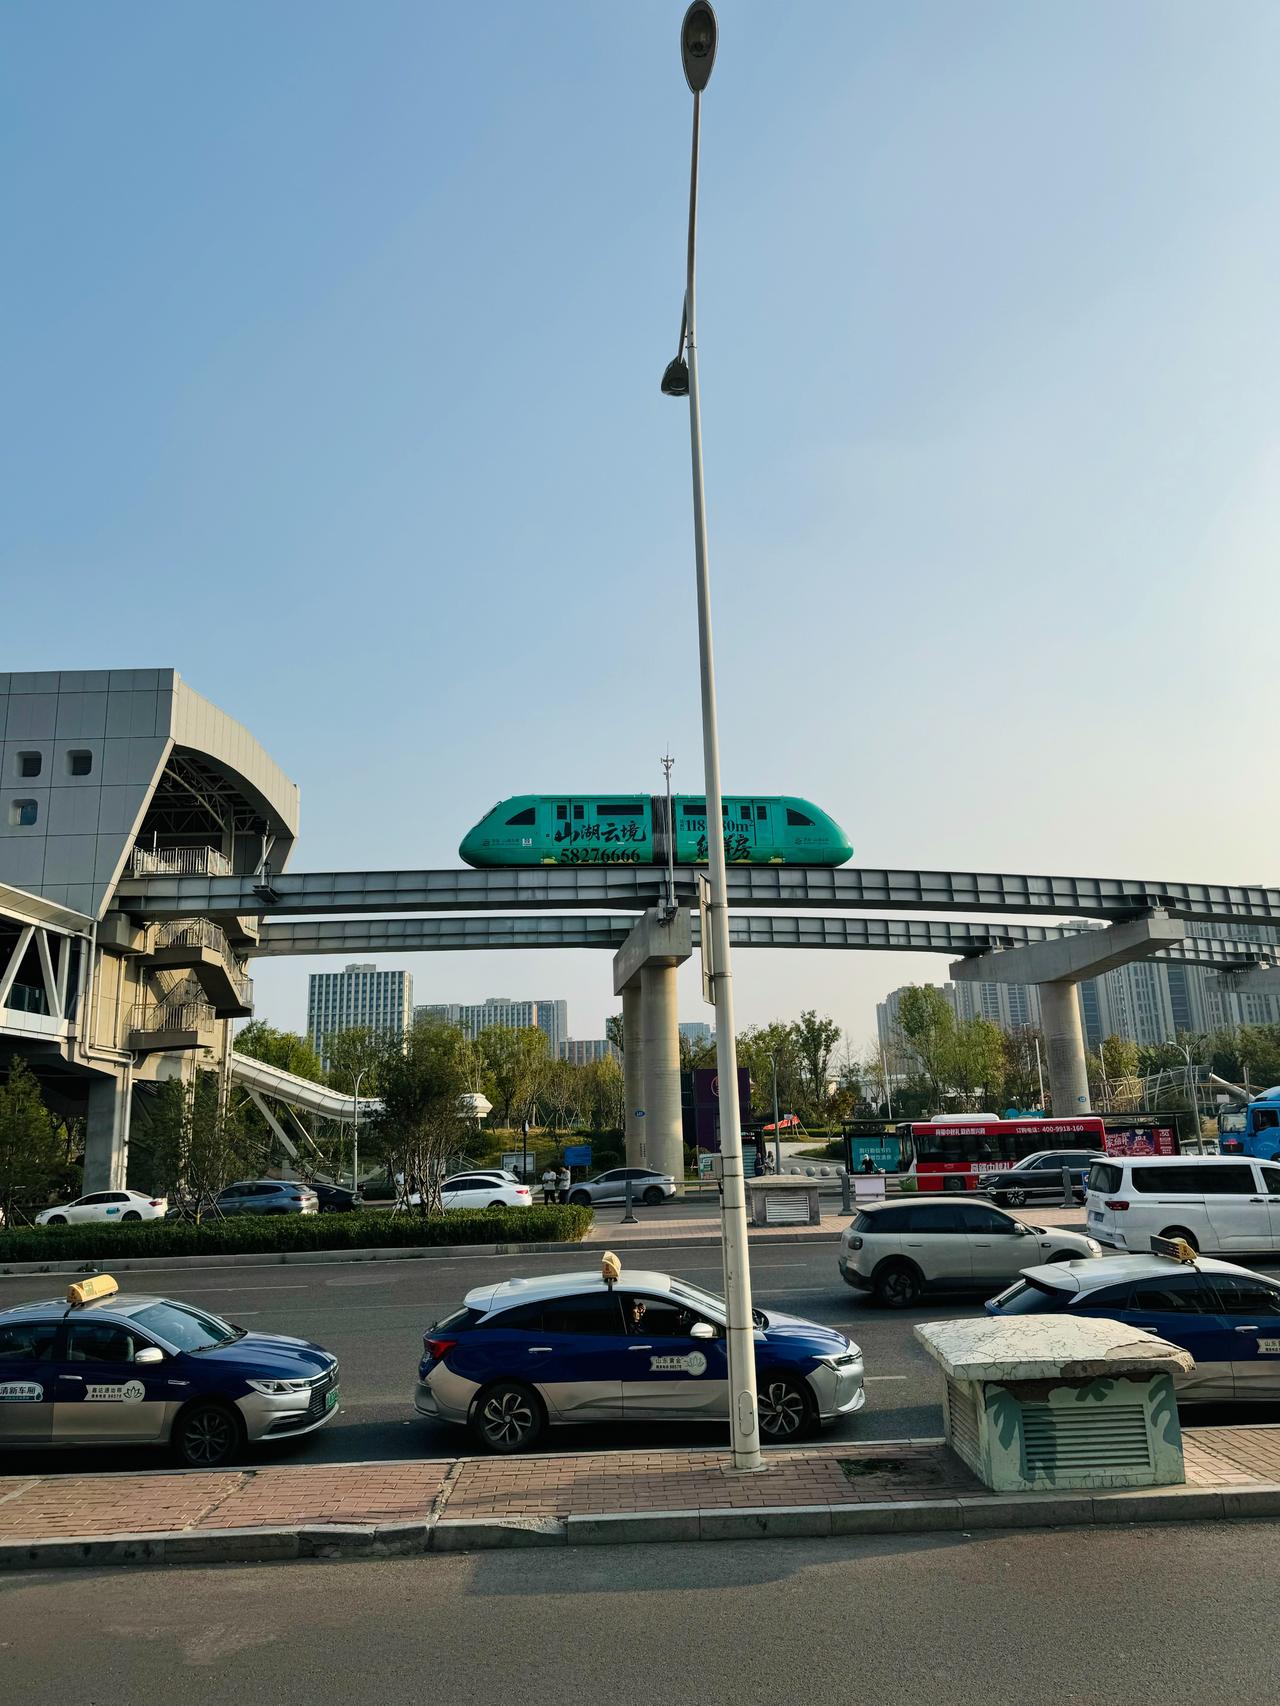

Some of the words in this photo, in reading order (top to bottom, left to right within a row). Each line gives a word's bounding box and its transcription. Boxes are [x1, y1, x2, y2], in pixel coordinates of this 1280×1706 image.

[554, 820, 647, 843] 山湖云境
[560, 848, 641, 863] 58276666
